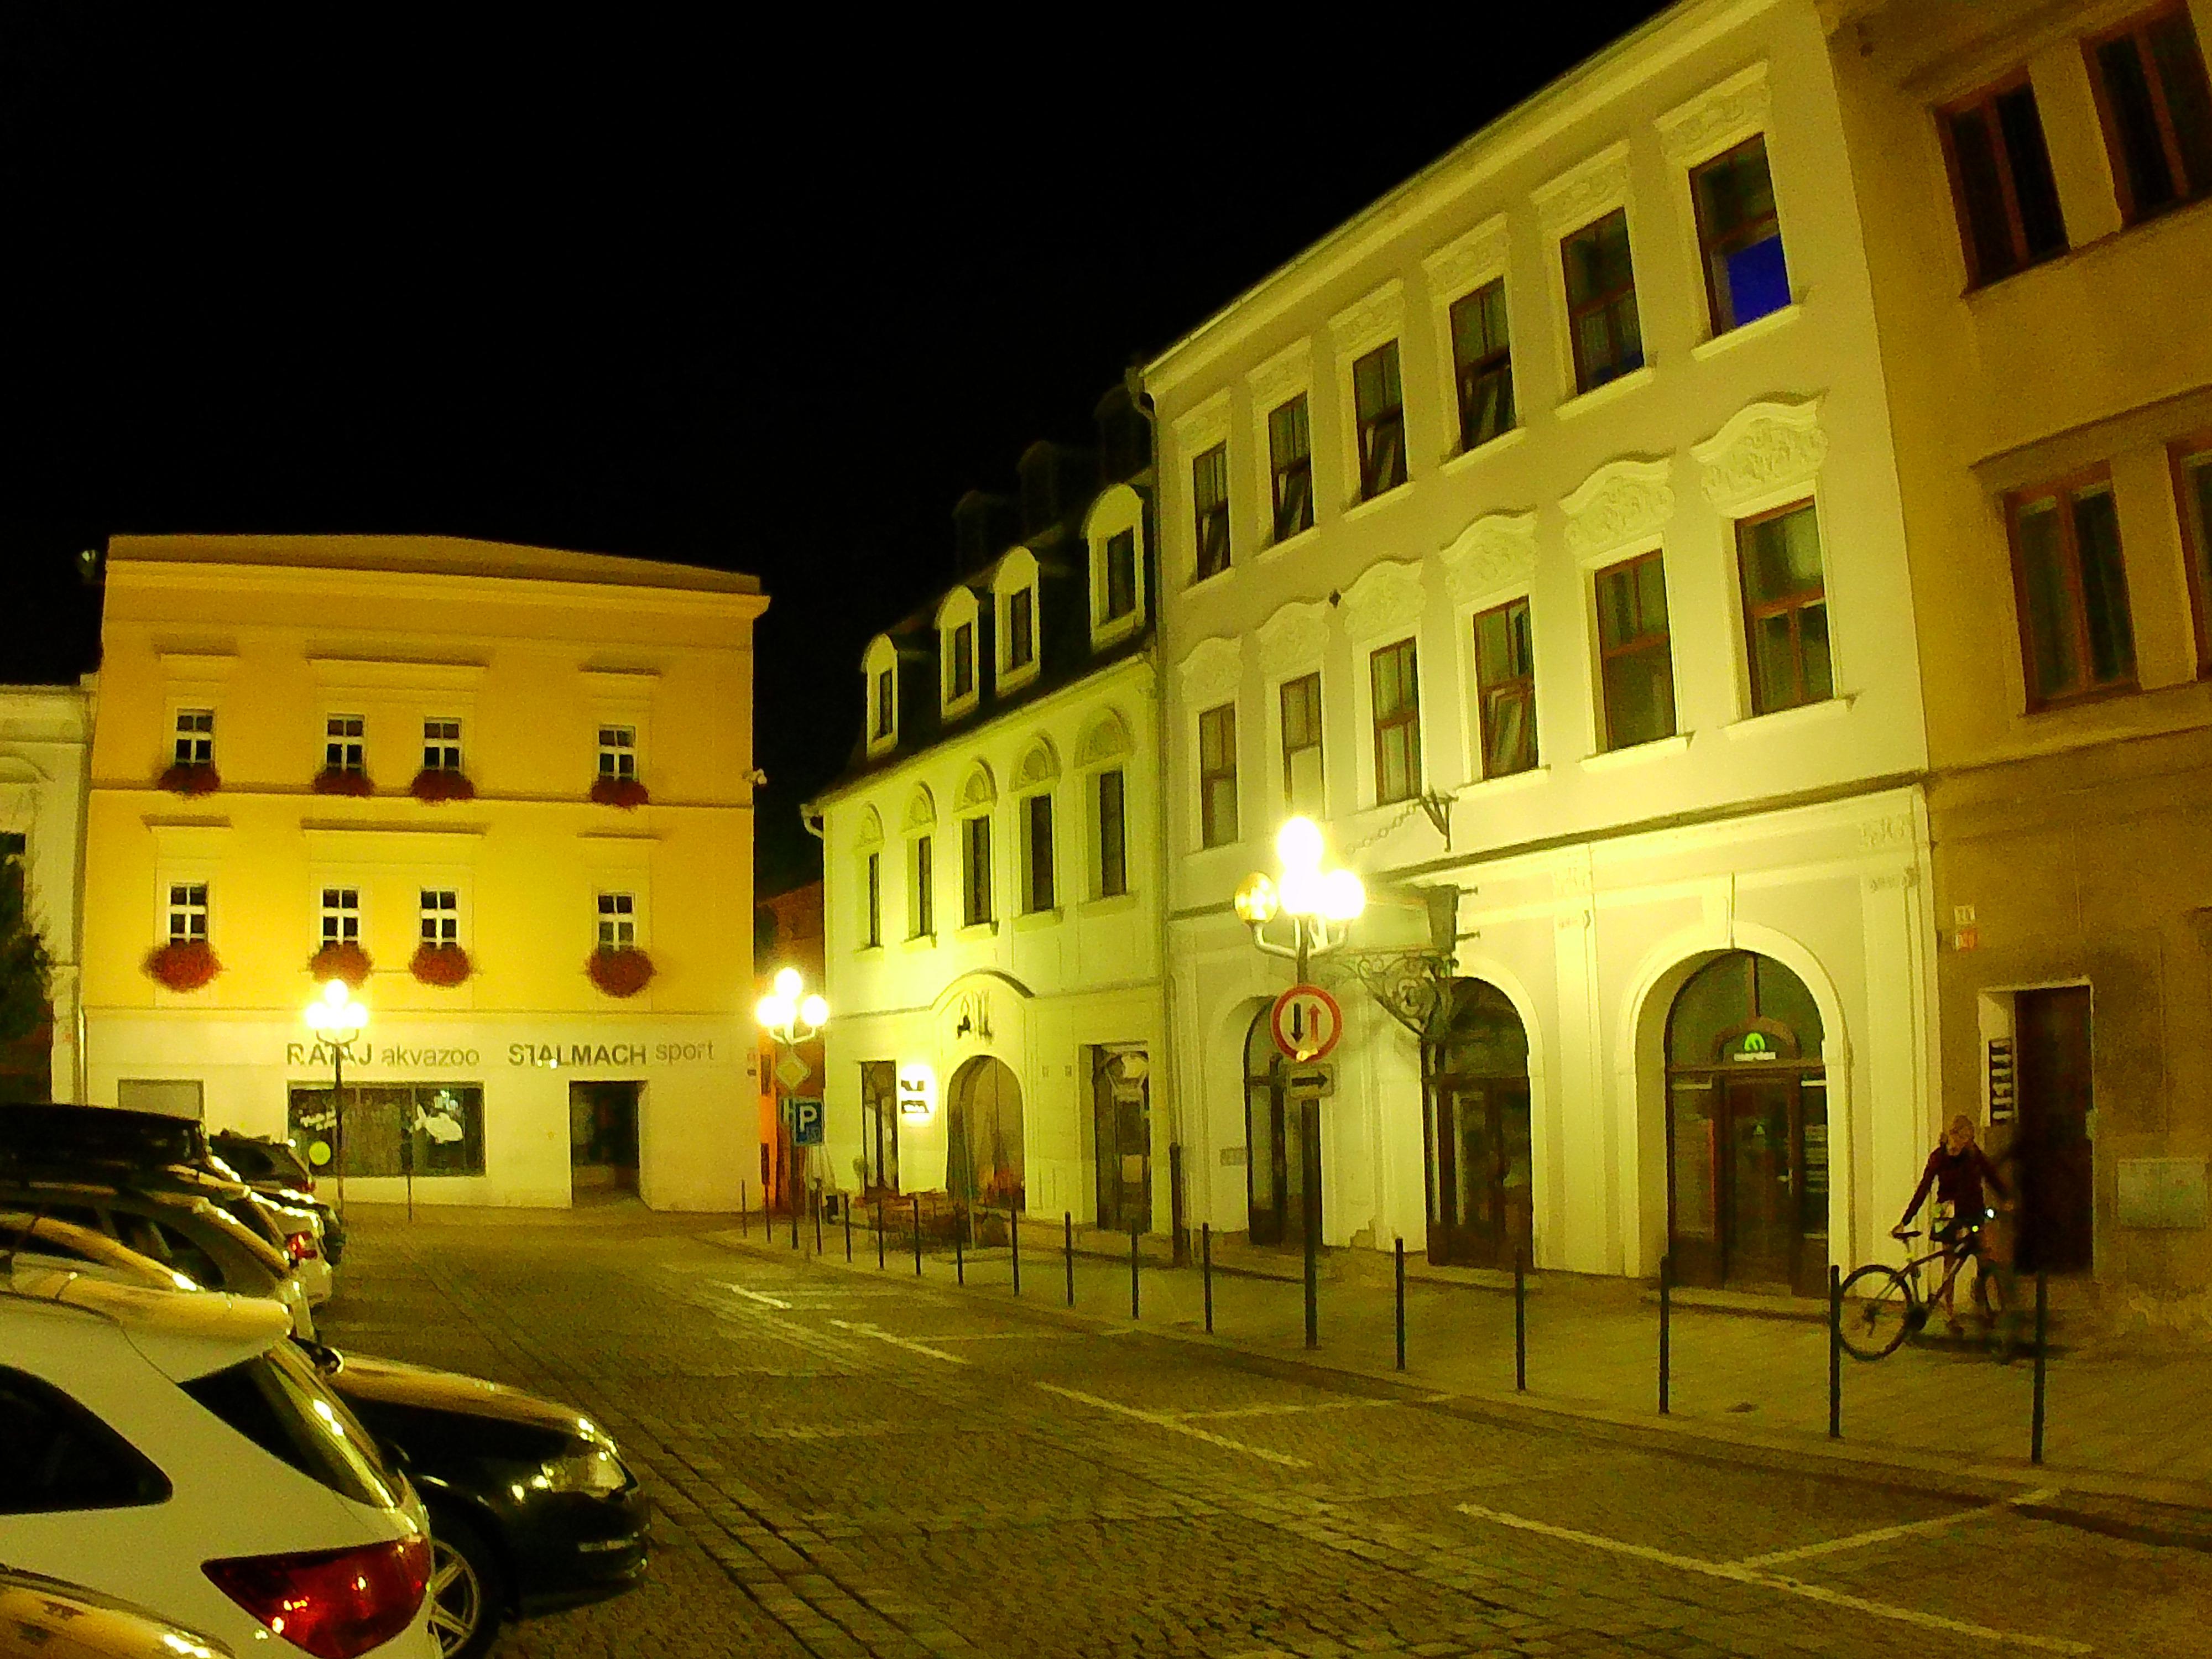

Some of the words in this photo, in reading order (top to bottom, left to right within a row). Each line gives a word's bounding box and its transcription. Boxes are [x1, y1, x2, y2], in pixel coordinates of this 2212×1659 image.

[382, 1045, 479, 1066] akvazoo
[509, 1044, 646, 1066] STALMACH
[655, 1041, 714, 1065] sport
[800, 1105, 817, 1133] P
